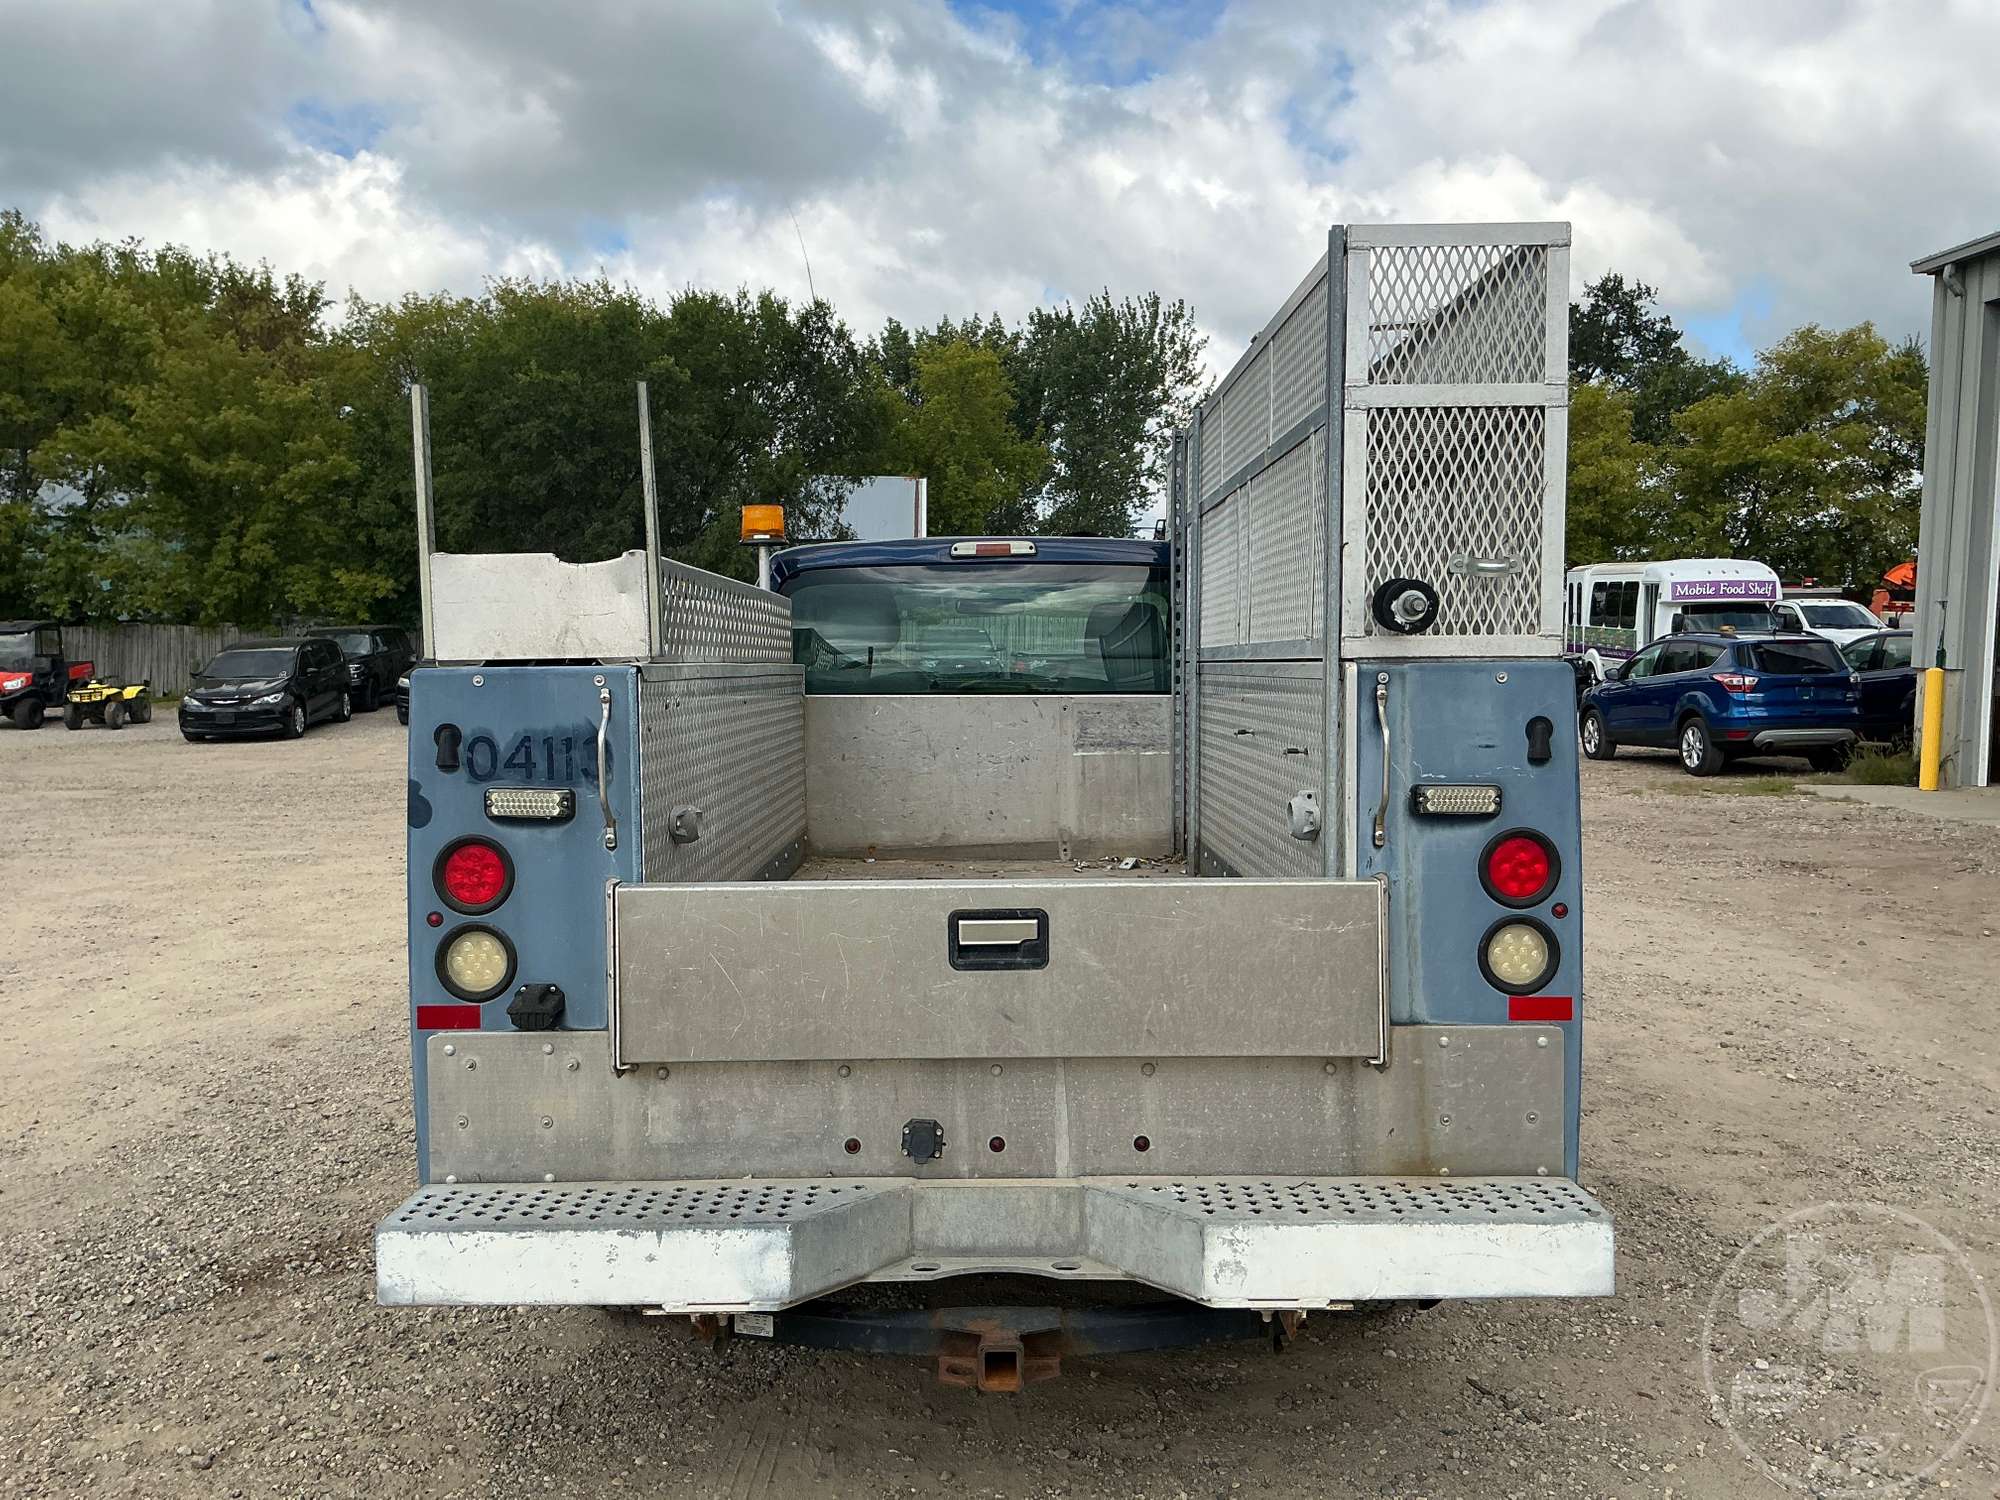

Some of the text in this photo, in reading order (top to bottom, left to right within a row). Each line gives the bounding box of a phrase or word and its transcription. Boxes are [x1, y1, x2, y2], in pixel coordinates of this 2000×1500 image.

[1675, 582, 1774, 597] Mobile Food Shelf
